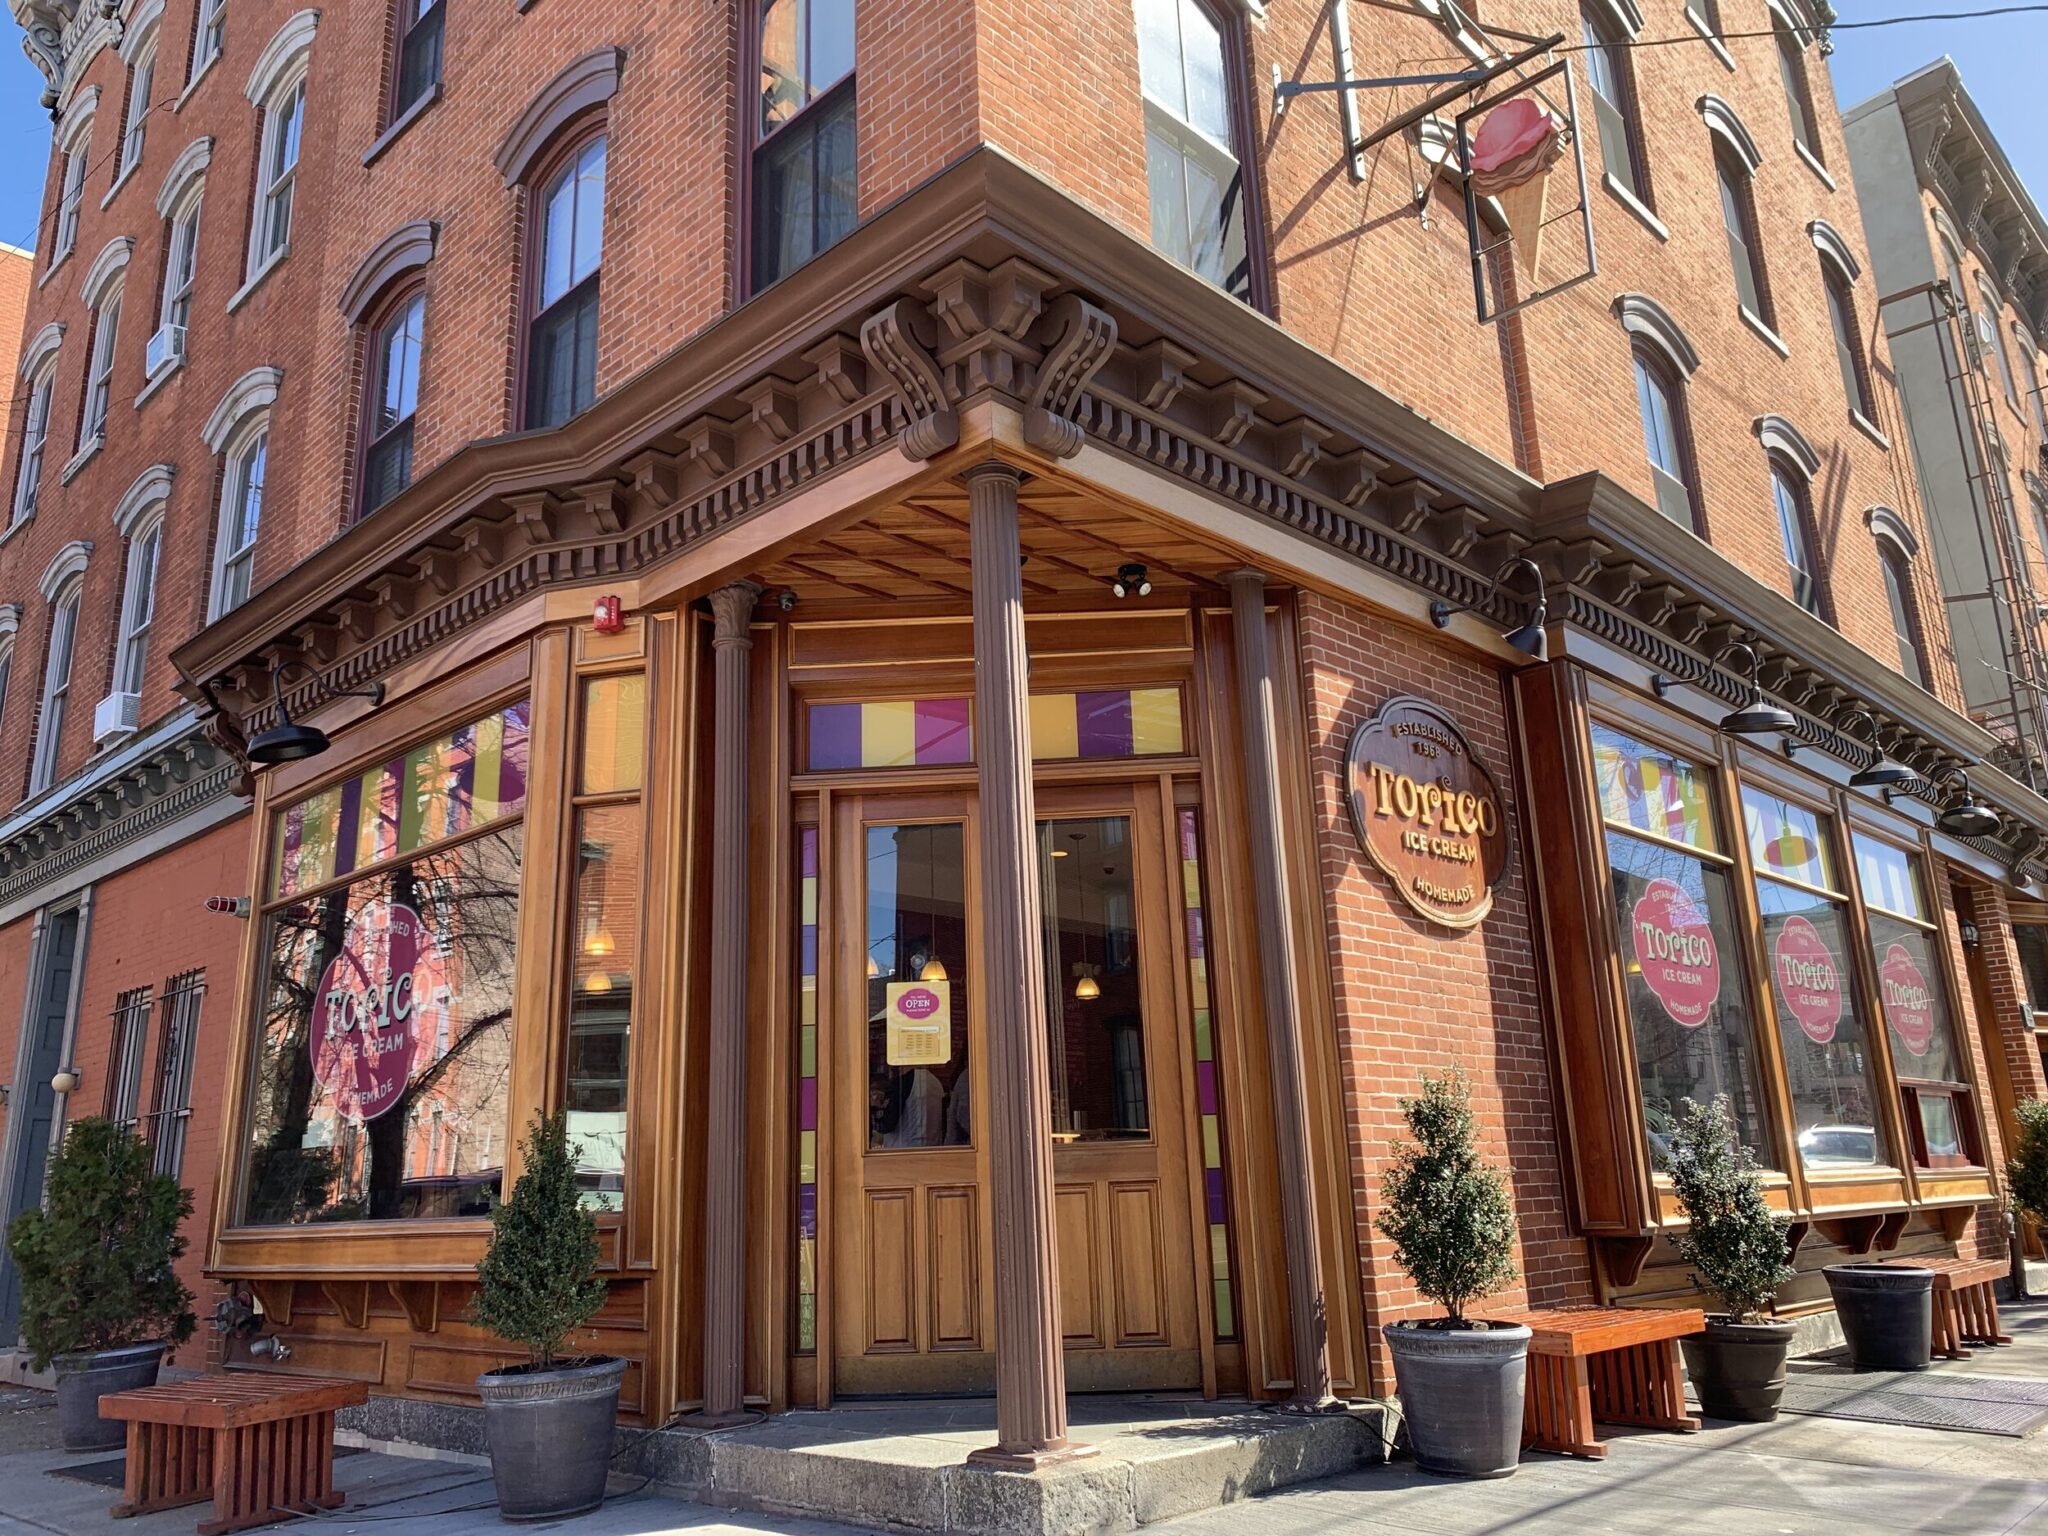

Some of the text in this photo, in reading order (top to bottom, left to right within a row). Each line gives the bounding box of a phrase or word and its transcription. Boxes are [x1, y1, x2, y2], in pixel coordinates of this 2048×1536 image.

[1396, 722, 1462, 756] ESTABLISHED
[1416, 742, 1441, 758] 1968
[1404, 829, 1478, 863] ICE CREAM
[1416, 875, 1475, 903] HOMEMADE
[1662, 967, 1702, 986] ICE CREAM
[905, 999, 930, 1009] OPEN
[1670, 999, 1702, 1016] HOMEMADE
[1799, 993, 1829, 1008] ICE CREAM
[363, 1033, 403, 1057] CREAM
[345, 1078, 394, 1106] OMEMADE
